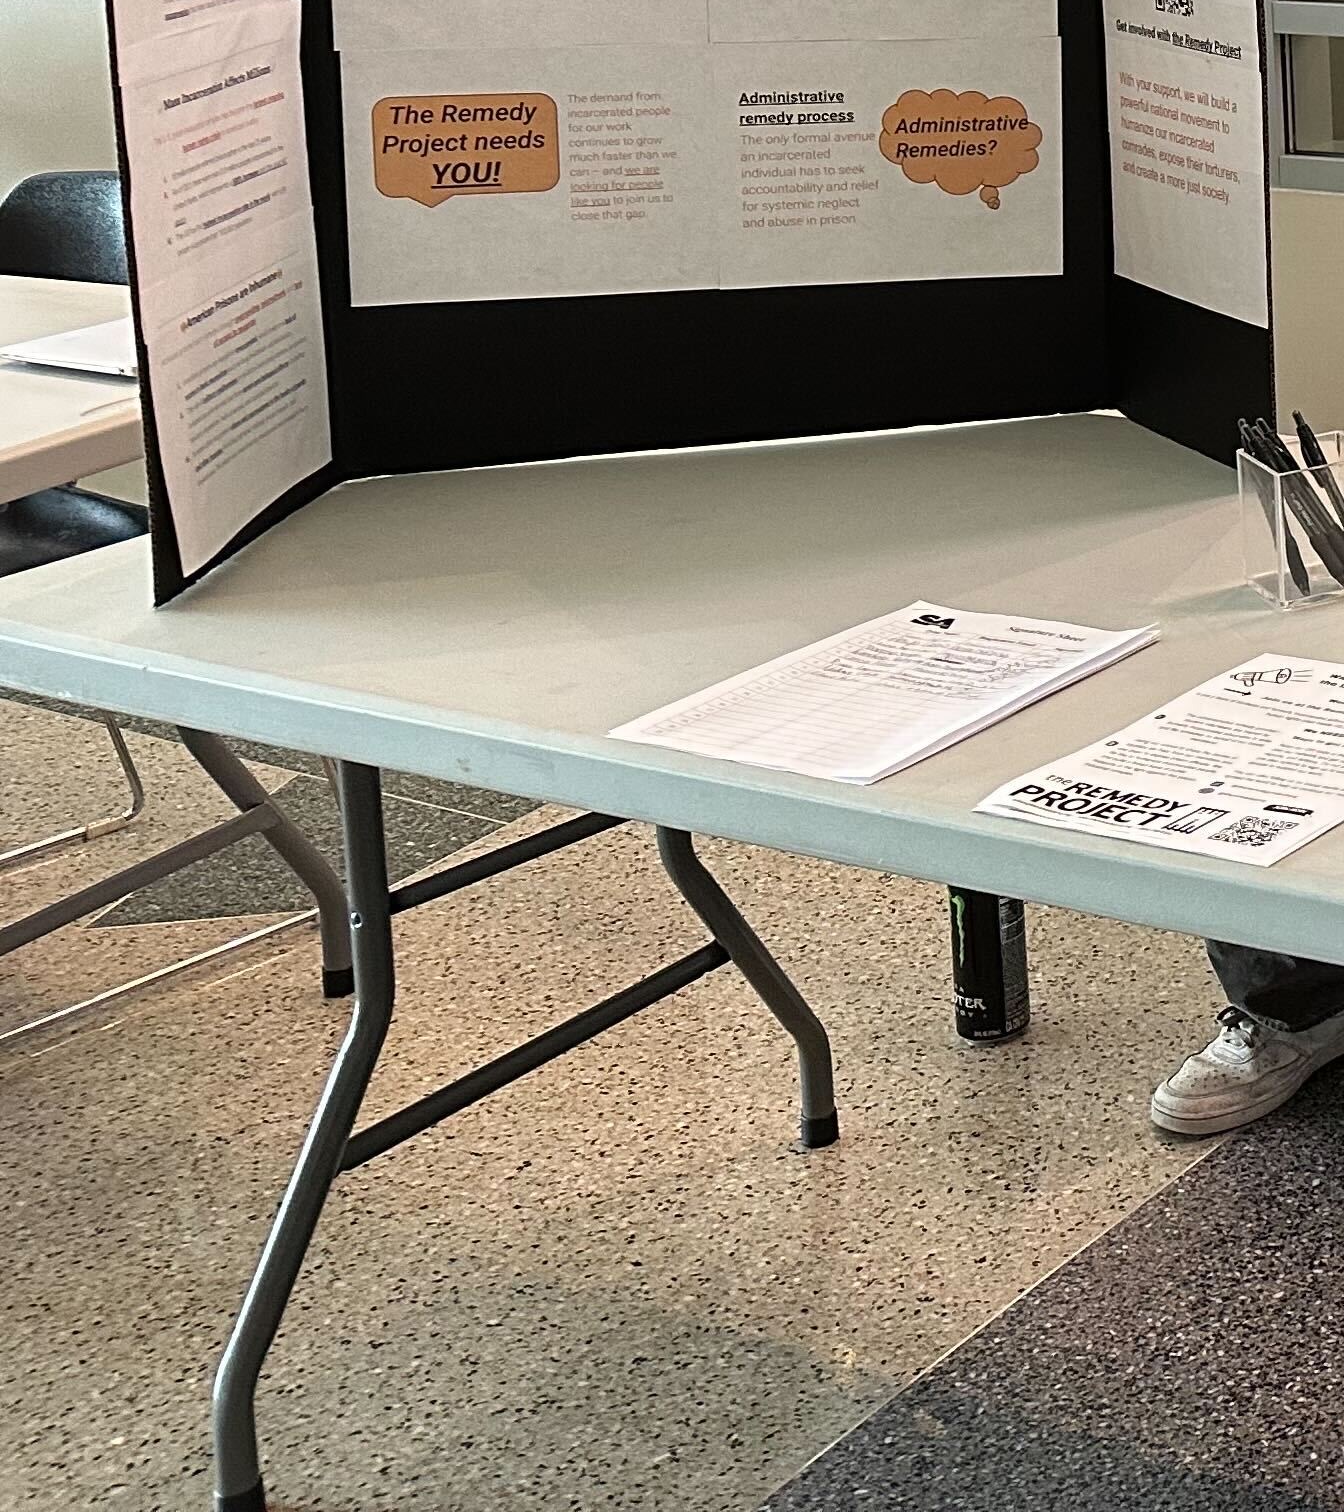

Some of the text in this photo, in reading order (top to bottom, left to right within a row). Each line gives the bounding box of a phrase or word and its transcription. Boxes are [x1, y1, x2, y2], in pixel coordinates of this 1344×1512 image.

[1185, 34, 1213, 53] Remedy
[1215, 41, 1241, 59] Project
[738, 90, 844, 104] Administrative
[389, 102, 537, 126] The Remedy
[739, 112, 855, 127] remedy process
[895, 115, 1029, 134] Administrative
[382, 130, 545, 158] Project needs
[896, 140, 997, 158] Remedies?
[431, 162, 502, 185] YOU!
[1009, 785, 1172, 825] PROJECT
[1046, 775, 1192, 812] the REMEDY
